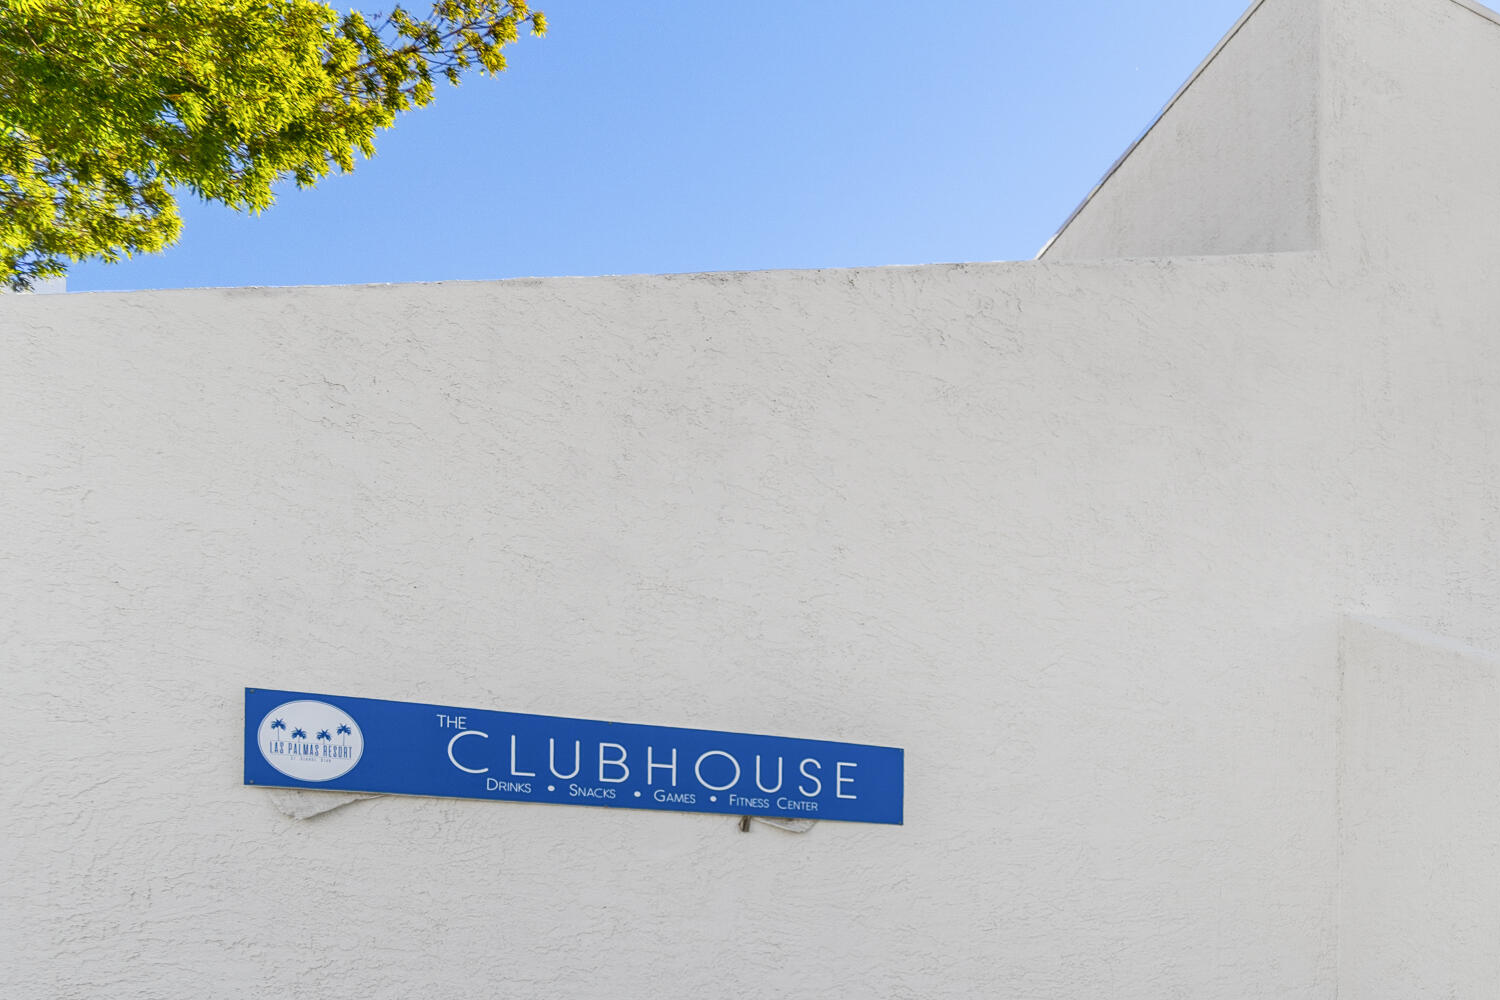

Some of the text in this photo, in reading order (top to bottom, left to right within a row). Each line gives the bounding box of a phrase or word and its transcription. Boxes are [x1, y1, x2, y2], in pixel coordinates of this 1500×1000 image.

[436, 714, 467, 730] THE
[269, 740, 353, 759] LAS PALMAS RESORT
[447, 730, 858, 800] CLUBHOUSE
